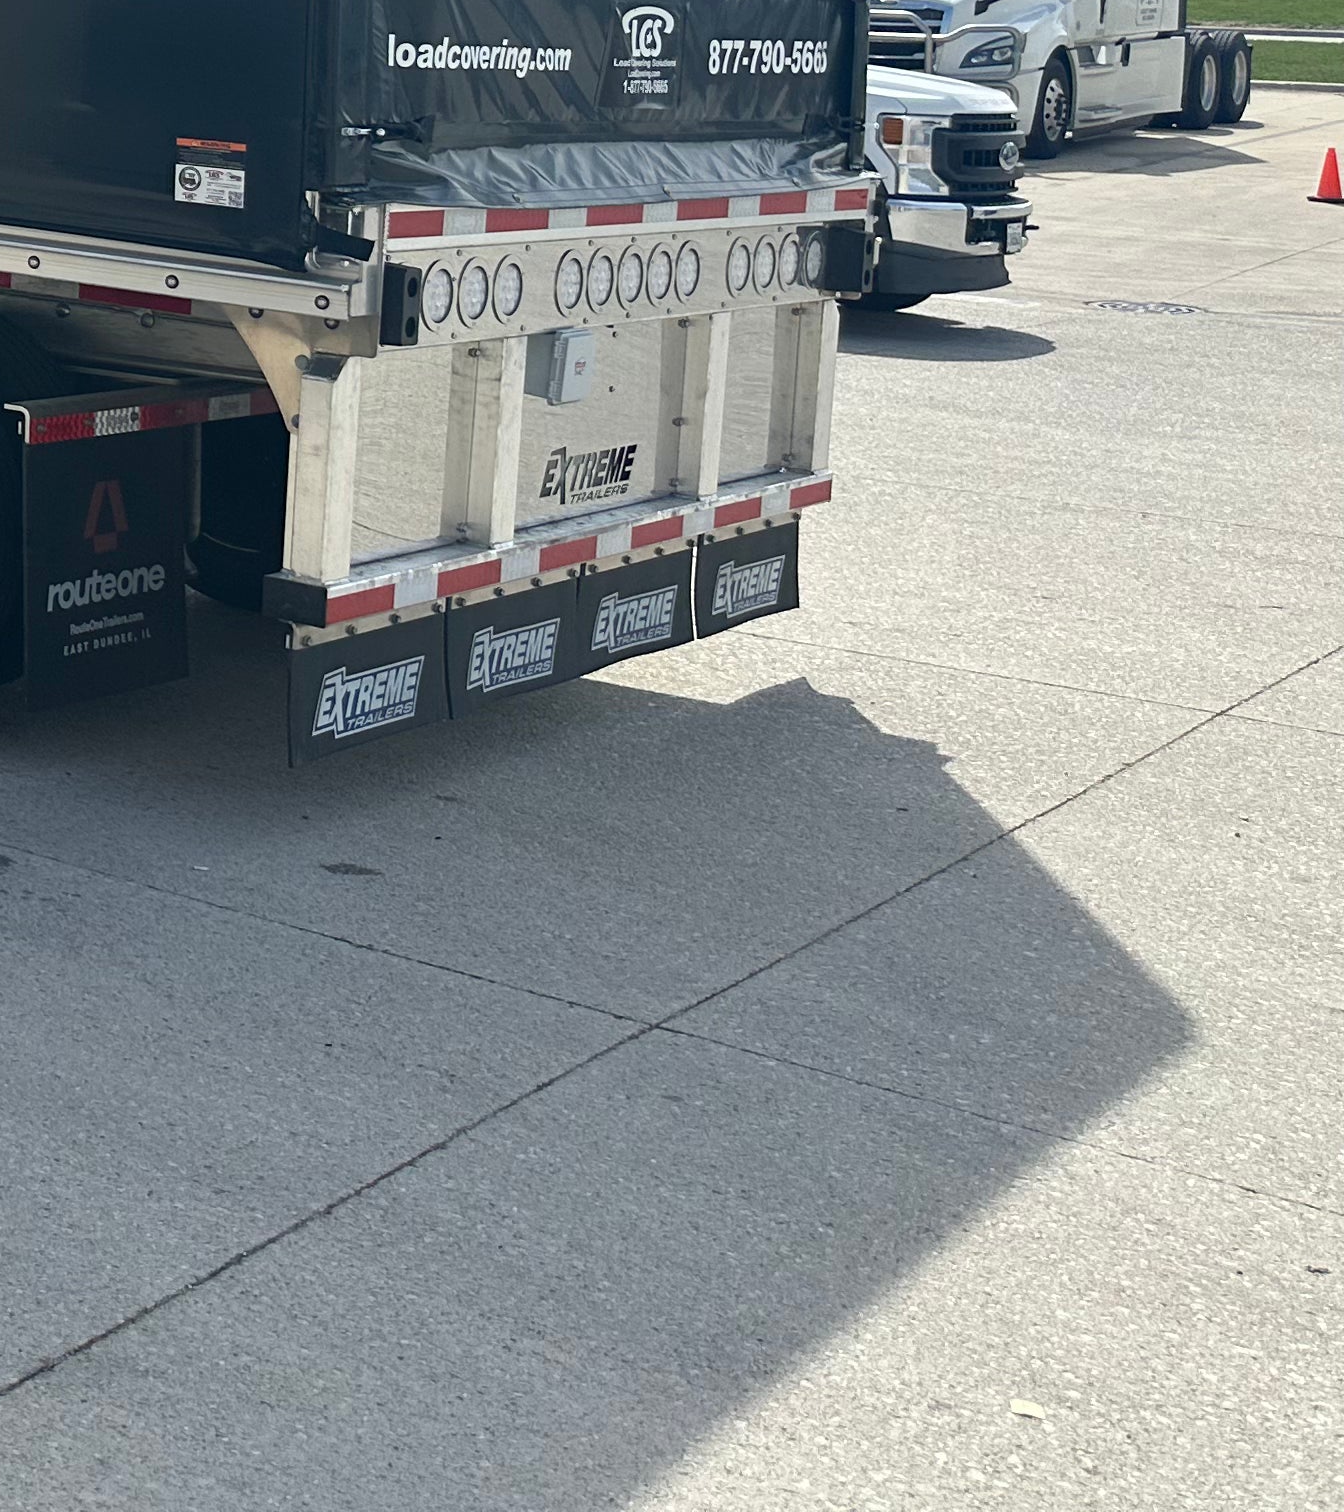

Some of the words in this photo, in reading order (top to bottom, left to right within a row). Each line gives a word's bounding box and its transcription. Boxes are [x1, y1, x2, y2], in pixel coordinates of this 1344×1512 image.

[387, 34, 572, 78] loadcovering.com
[631, 19, 662, 58] LCS
[539, 444, 638, 506] EXTREME
[570, 483, 629, 504] TRAILERS
[47, 564, 166, 613] routeone
[715, 559, 783, 614] EXTREME
[733, 590, 777, 612] TRAILERS
[596, 590, 675, 648] EXTREME
[615, 623, 671, 647] TRAILERS
[63, 641, 89, 657] EAST
[469, 623, 557, 687] EXTREME
[491, 659, 552, 685] TRAILERS
[316, 661, 420, 732] EXTREME
[346, 700, 414, 730] TRAILERS
